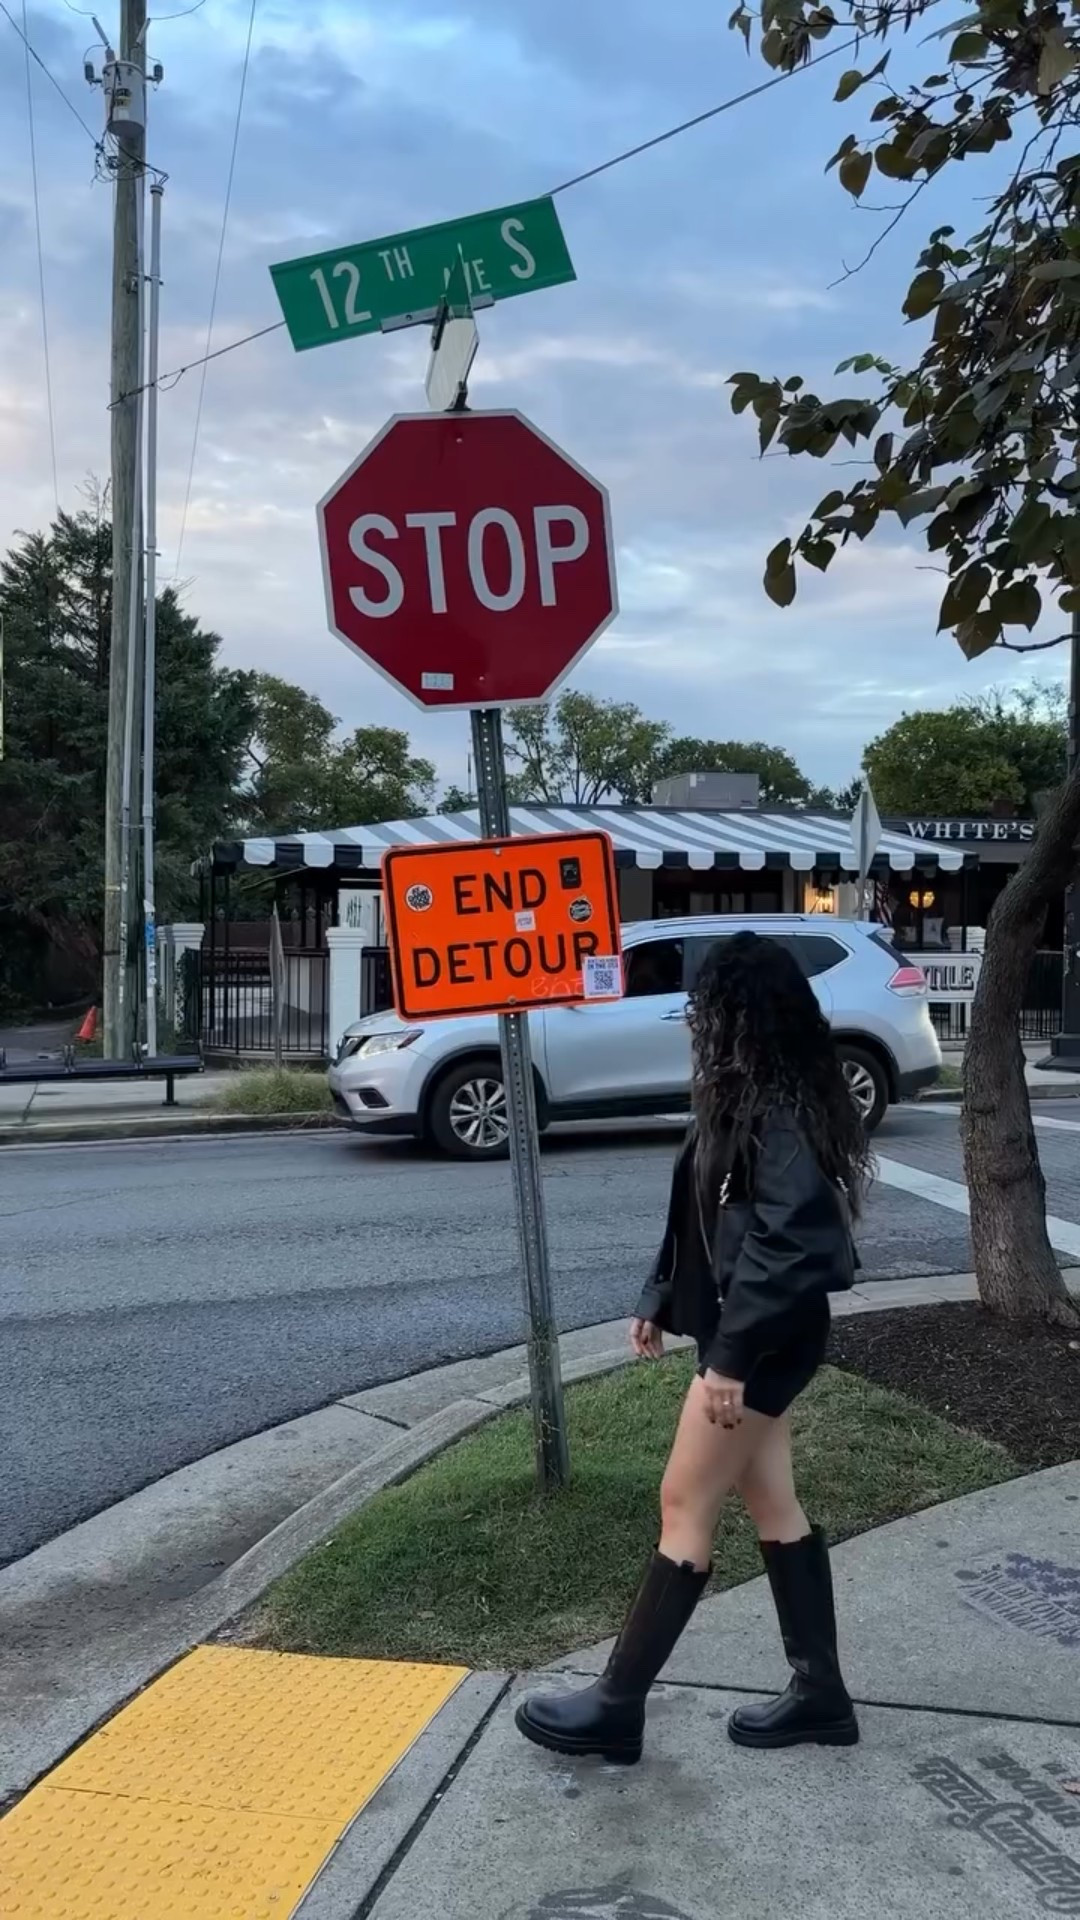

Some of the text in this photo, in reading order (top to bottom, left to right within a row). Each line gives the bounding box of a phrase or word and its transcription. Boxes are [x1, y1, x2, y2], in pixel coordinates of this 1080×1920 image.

[310, 261, 372, 328] 12
[378, 246, 415, 281] TH
[501, 218, 536, 279] S
[348, 504, 590, 618] STOP
[907, 821, 1034, 841] WHITE'S
[453, 869, 547, 915] END
[412, 931, 599, 988] DETOUR
